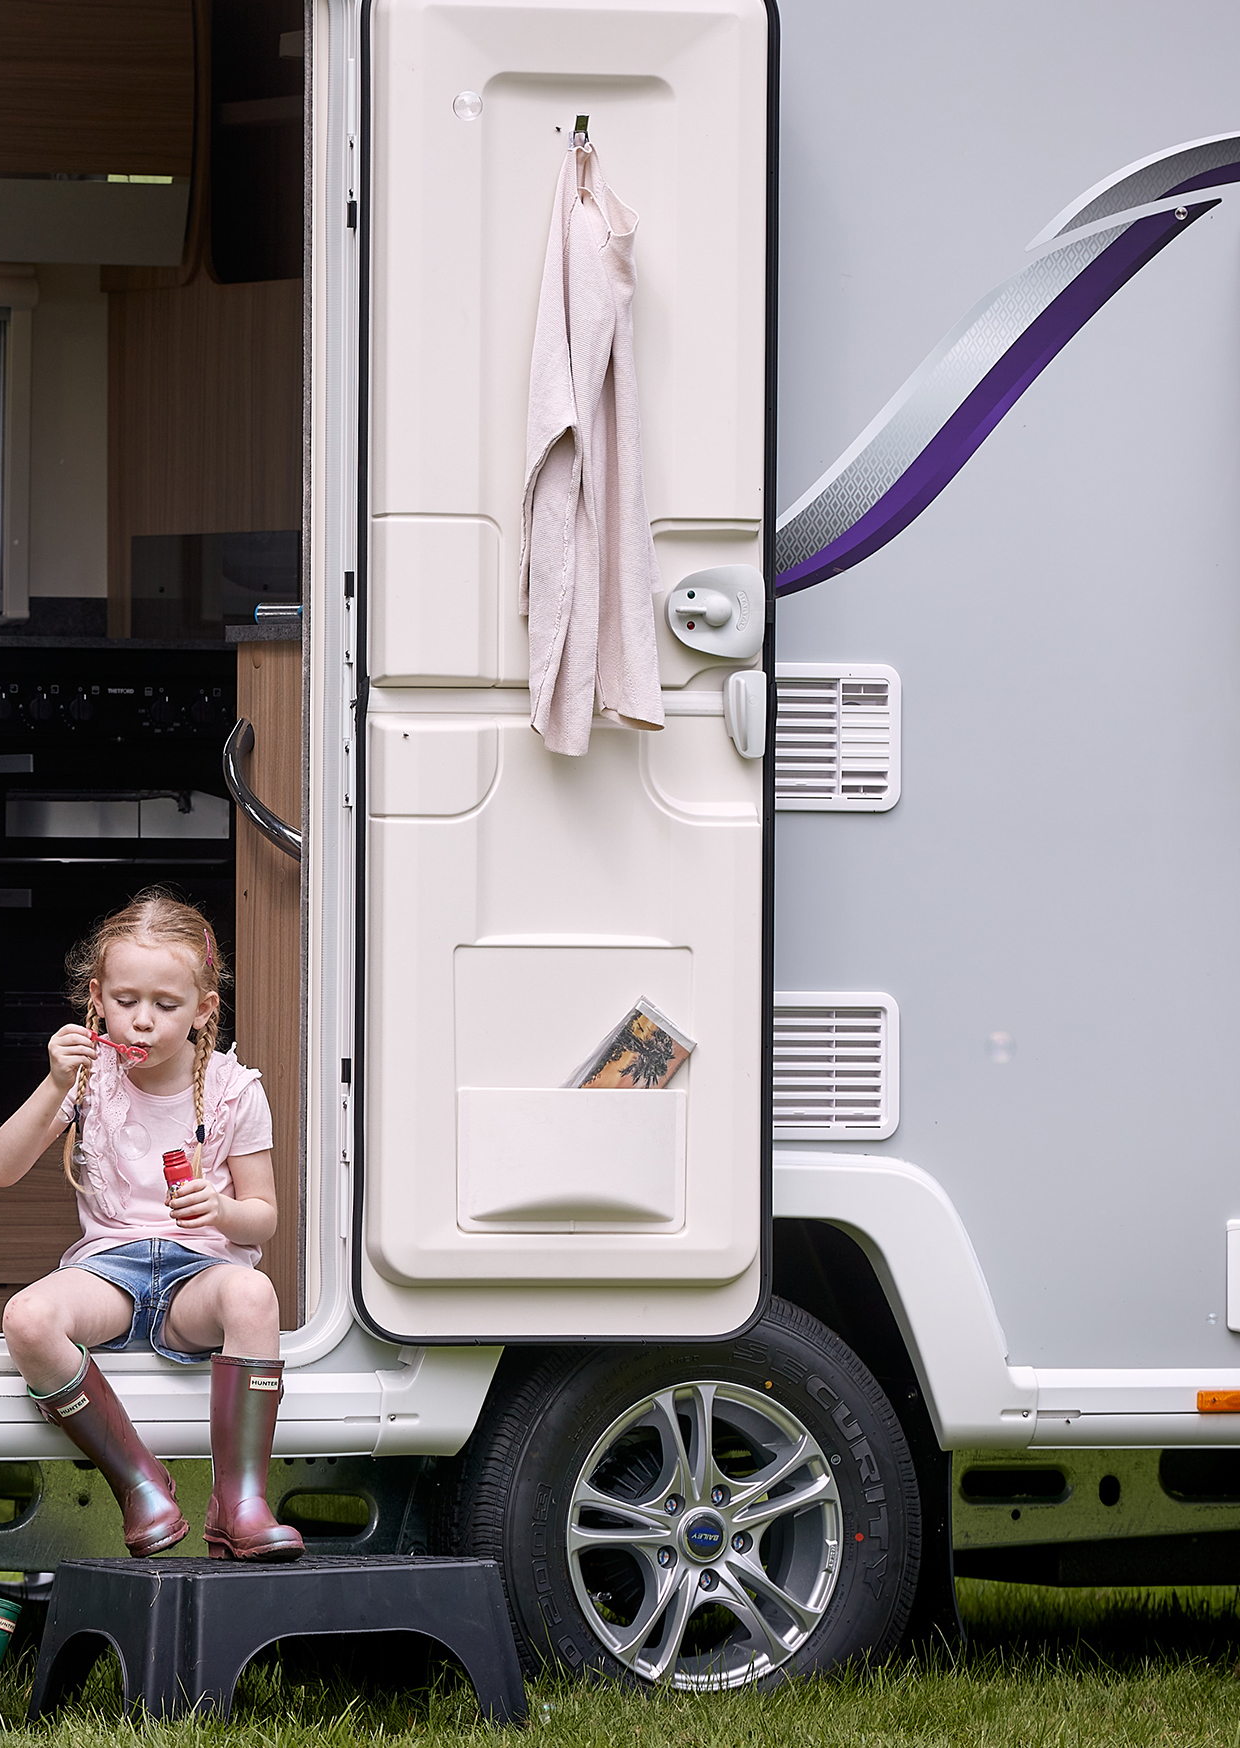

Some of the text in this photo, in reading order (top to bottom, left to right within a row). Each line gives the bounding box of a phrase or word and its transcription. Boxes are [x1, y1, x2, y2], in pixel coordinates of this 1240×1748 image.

[107, 687, 135, 695] THETFORD
[59, 1397, 87, 1415] HUNTER
[733, 1337, 890, 1601] SECURITY
[691, 1532, 720, 1542] BAILEY
